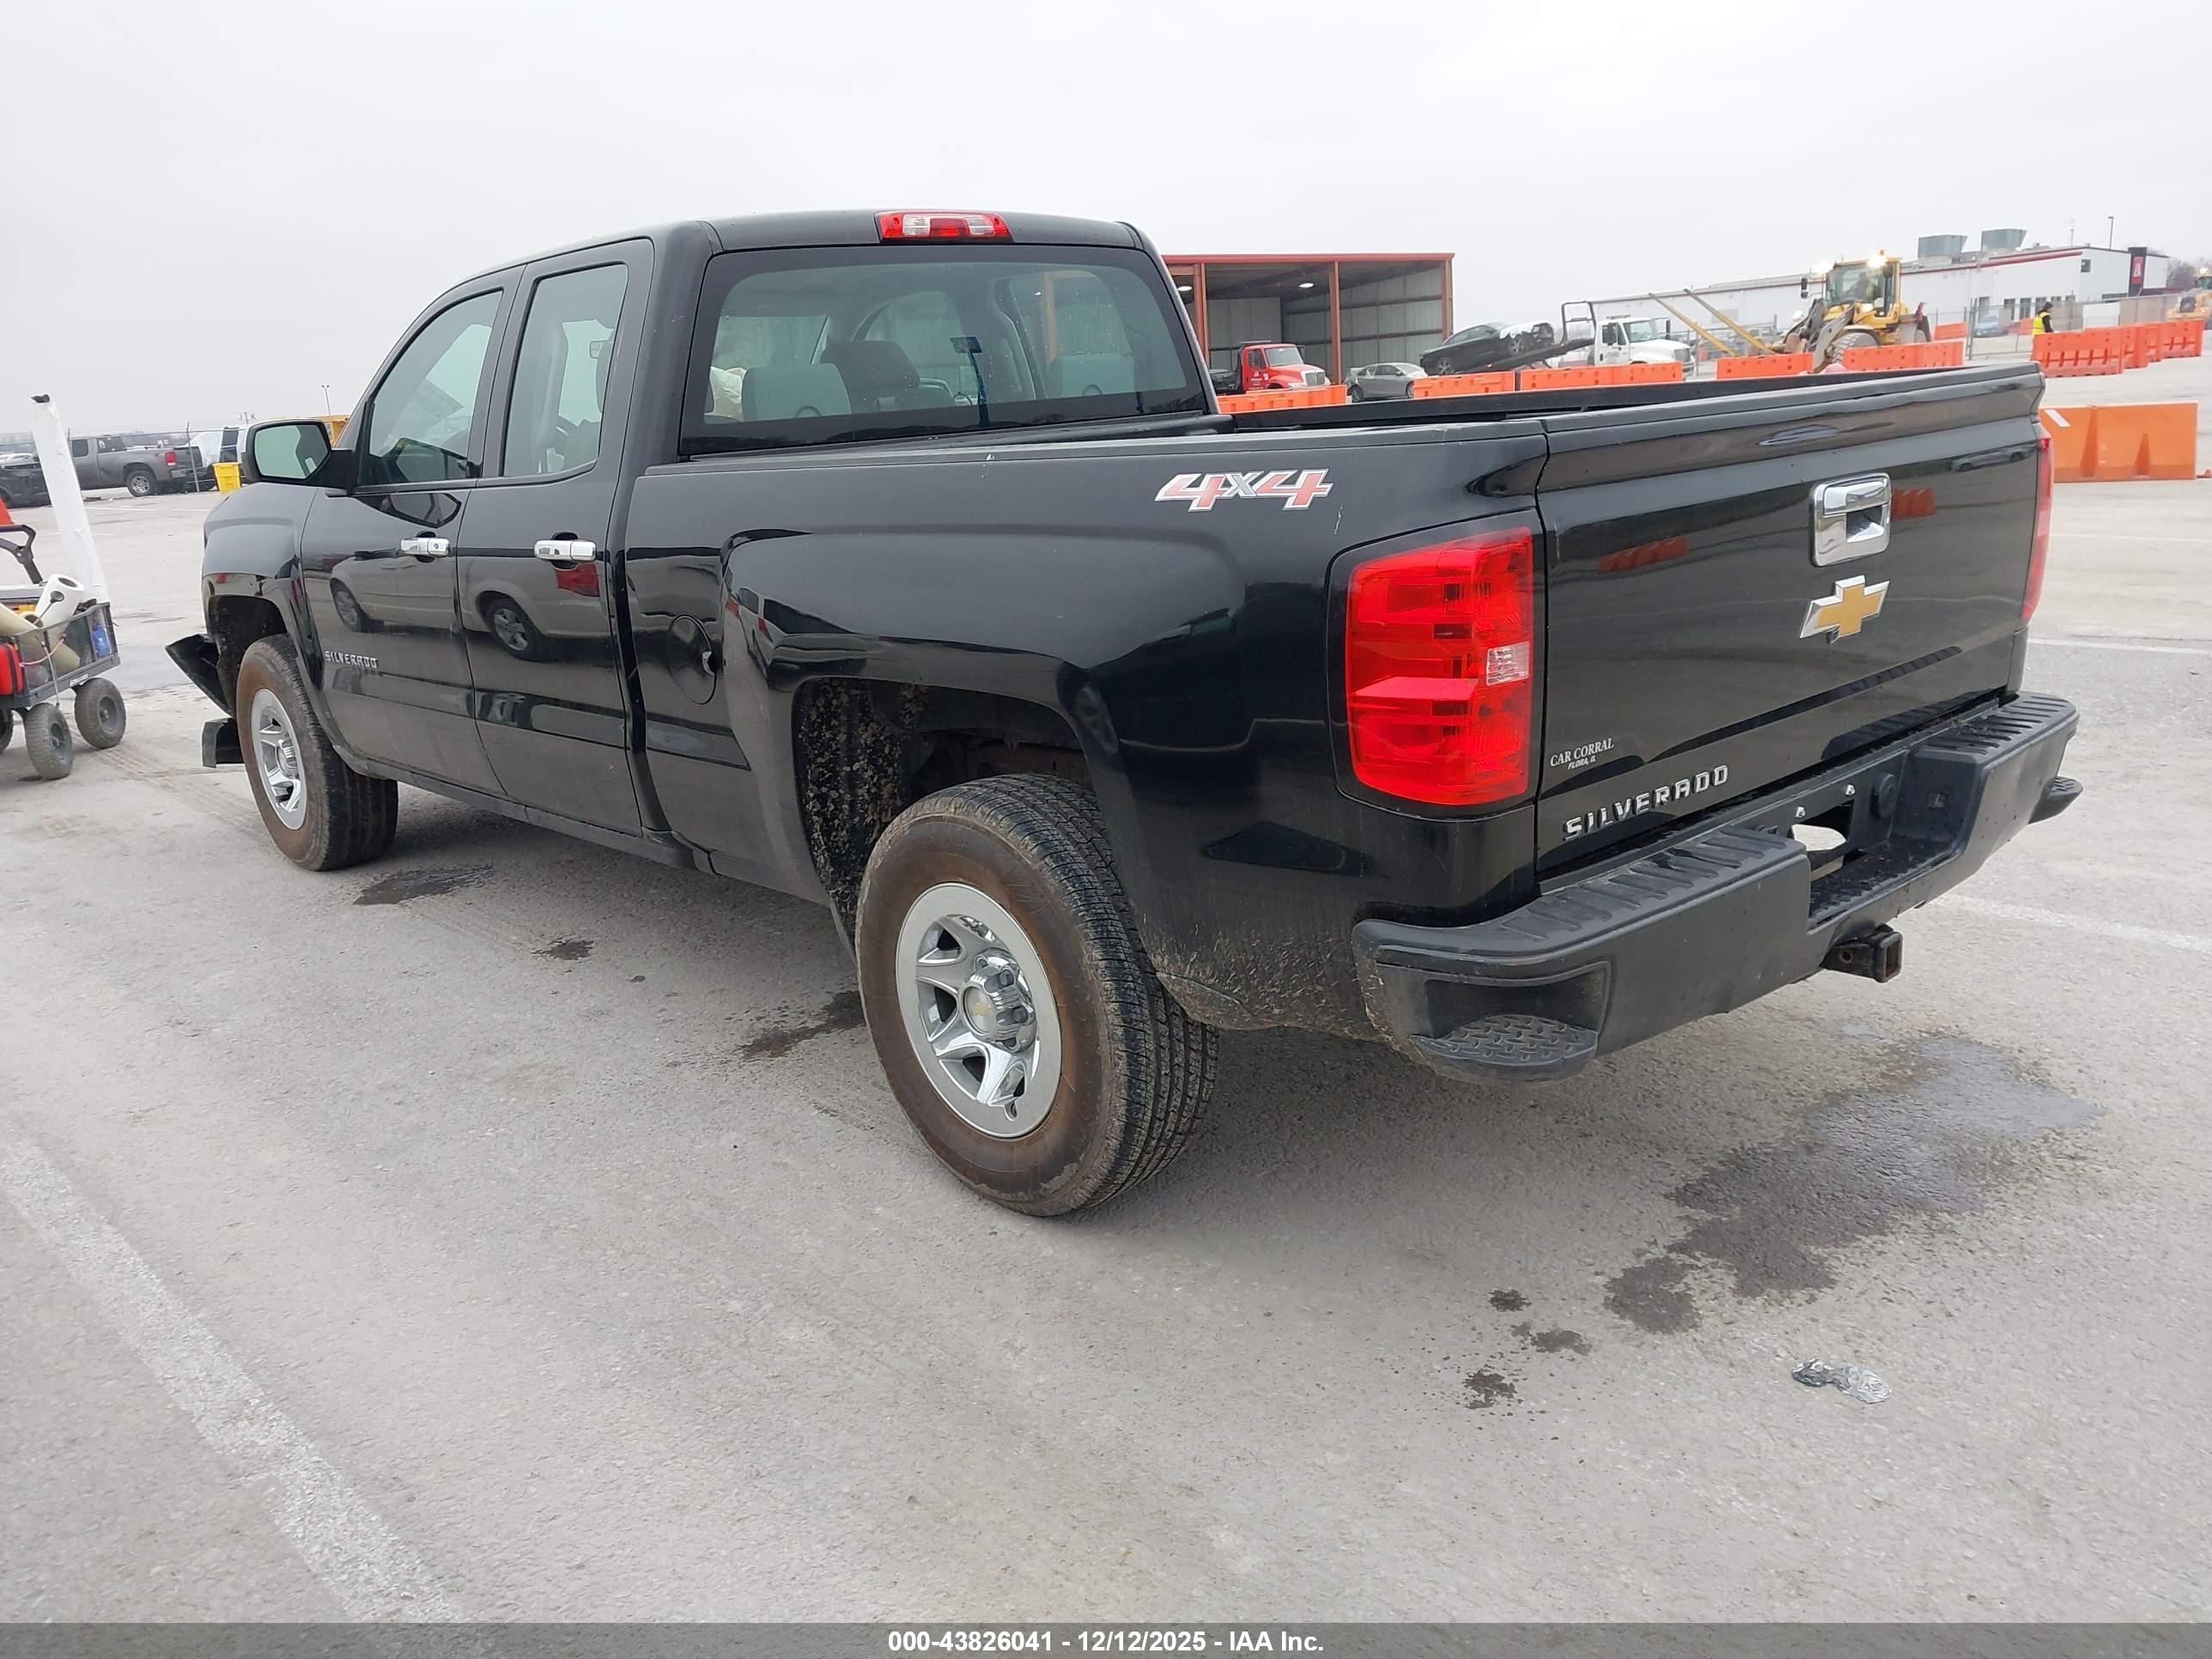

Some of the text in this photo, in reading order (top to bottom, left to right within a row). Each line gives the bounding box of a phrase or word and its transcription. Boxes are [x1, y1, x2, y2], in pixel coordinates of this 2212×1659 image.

[325, 651, 378, 668] SILVERADO
[1550, 738, 1614, 766] CAR CORRAL
[1565, 764, 1729, 841] SILVERADO
